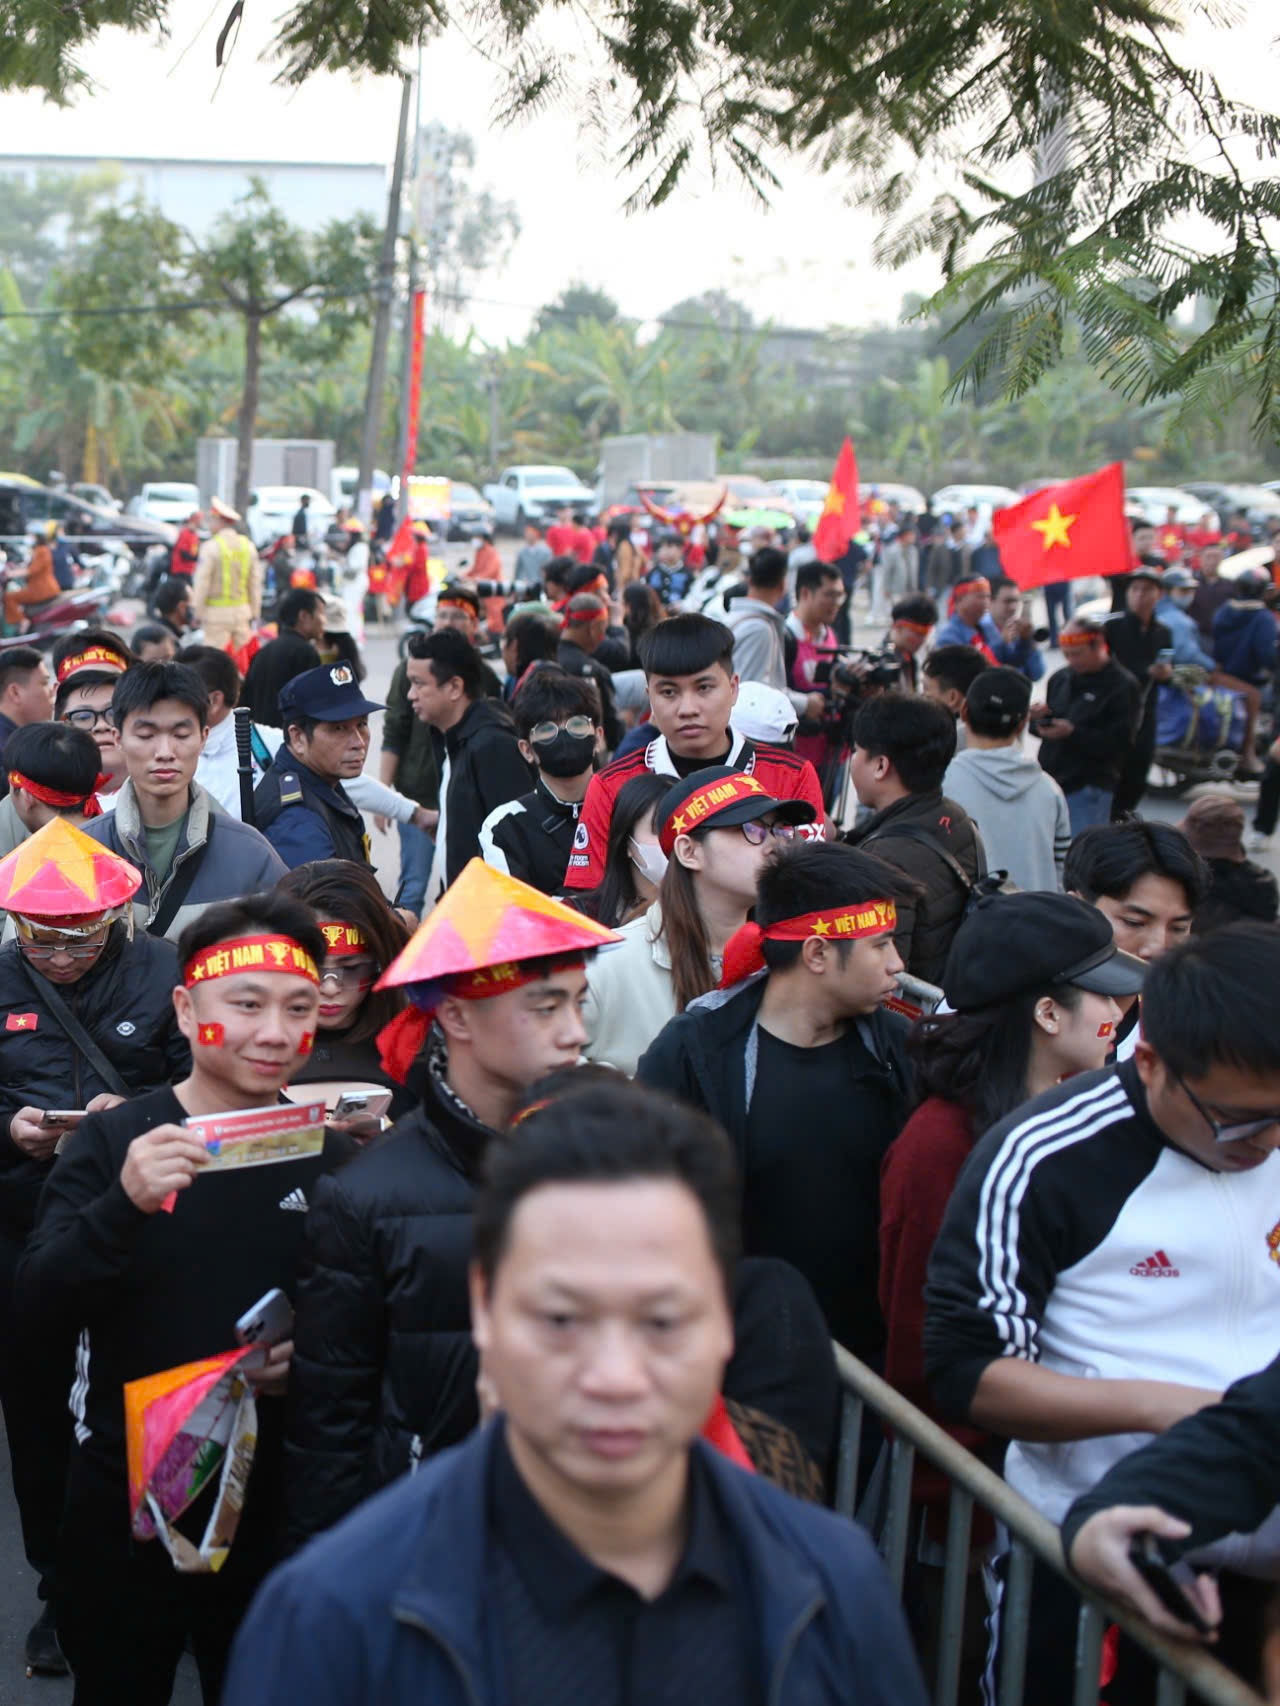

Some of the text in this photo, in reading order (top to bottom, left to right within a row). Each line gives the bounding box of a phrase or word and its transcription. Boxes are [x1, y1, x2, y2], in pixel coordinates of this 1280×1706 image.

[685, 783, 738, 819] VIỆT NAM
[835, 914, 856, 935] VIỆT
[857, 910, 878, 929] NAM
[206, 951, 231, 976] VIỆT
[232, 945, 264, 968] NAM
[1129, 1267, 1179, 1278] adidas
